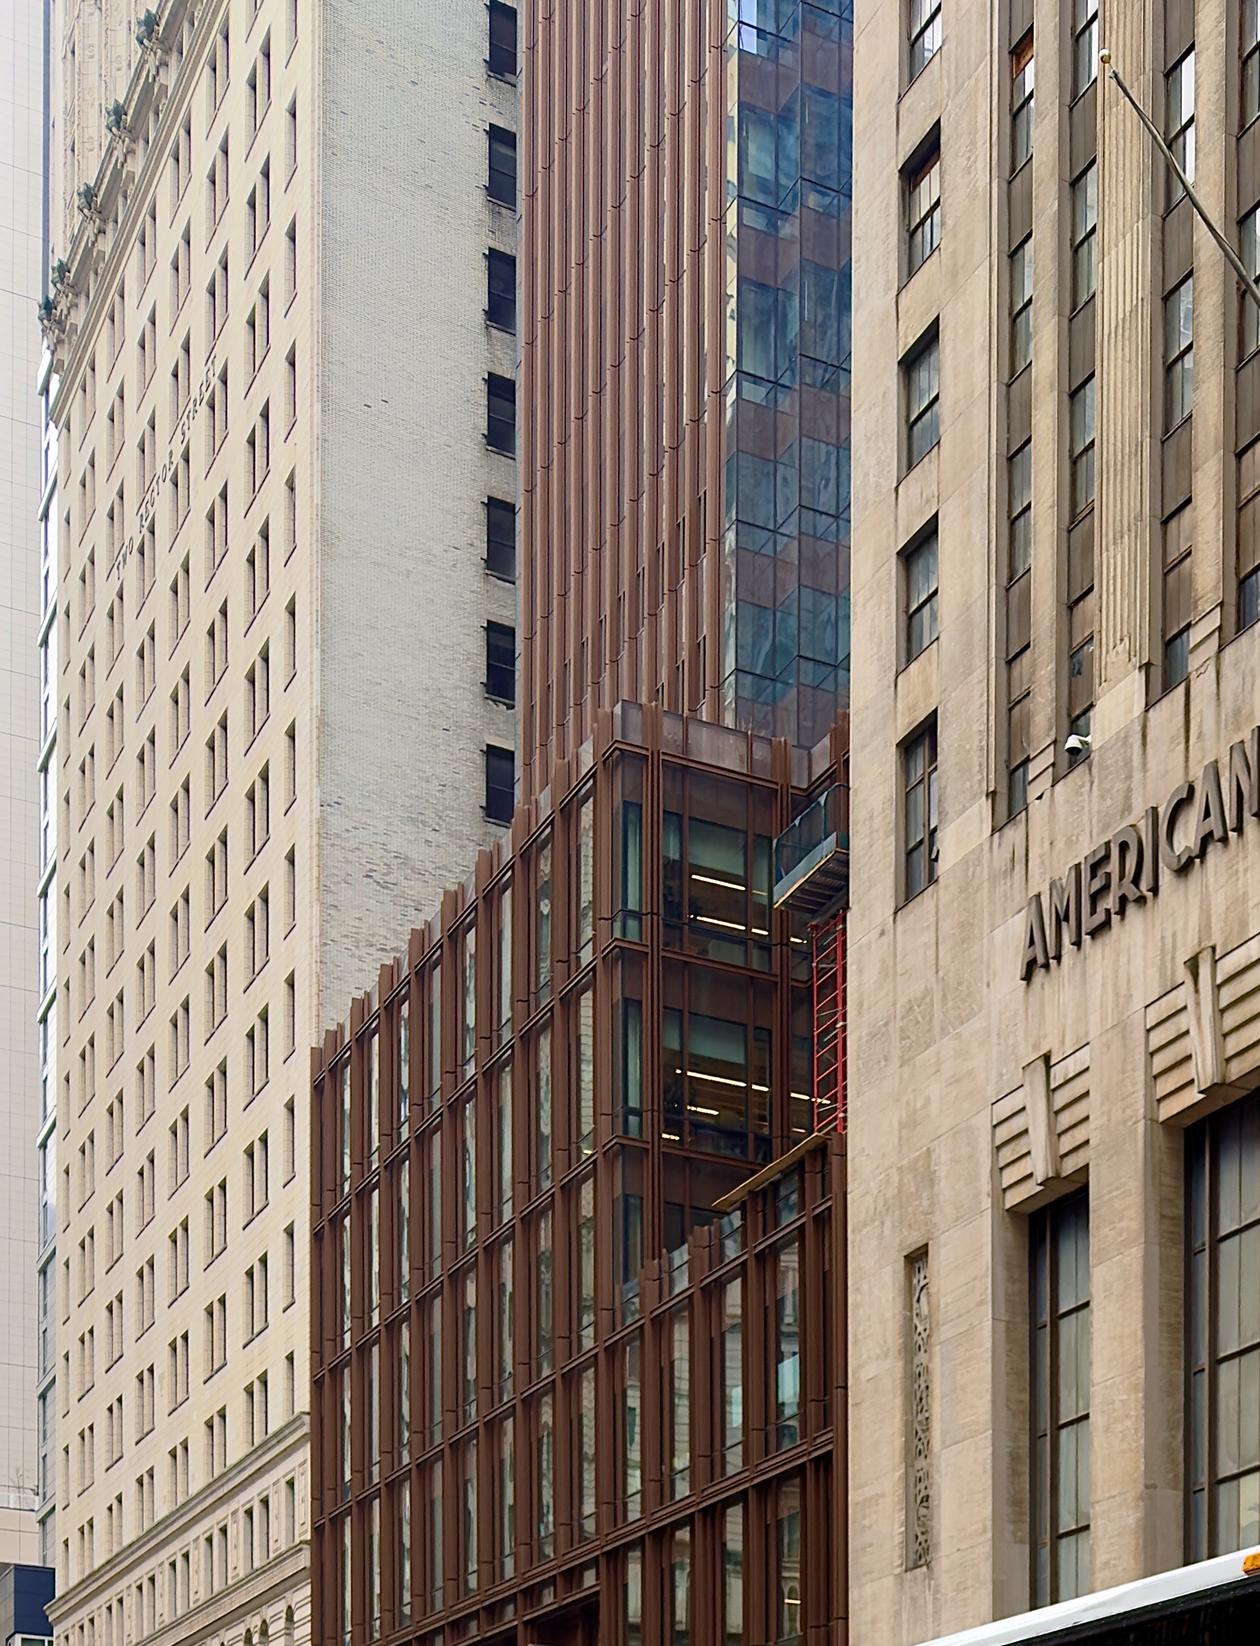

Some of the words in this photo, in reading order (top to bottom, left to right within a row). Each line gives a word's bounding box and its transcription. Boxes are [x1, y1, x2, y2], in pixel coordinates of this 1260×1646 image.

[115, 536, 134, 581] TWO
[139, 449, 174, 534] RECTOR
[180, 353, 217, 445] STREET
